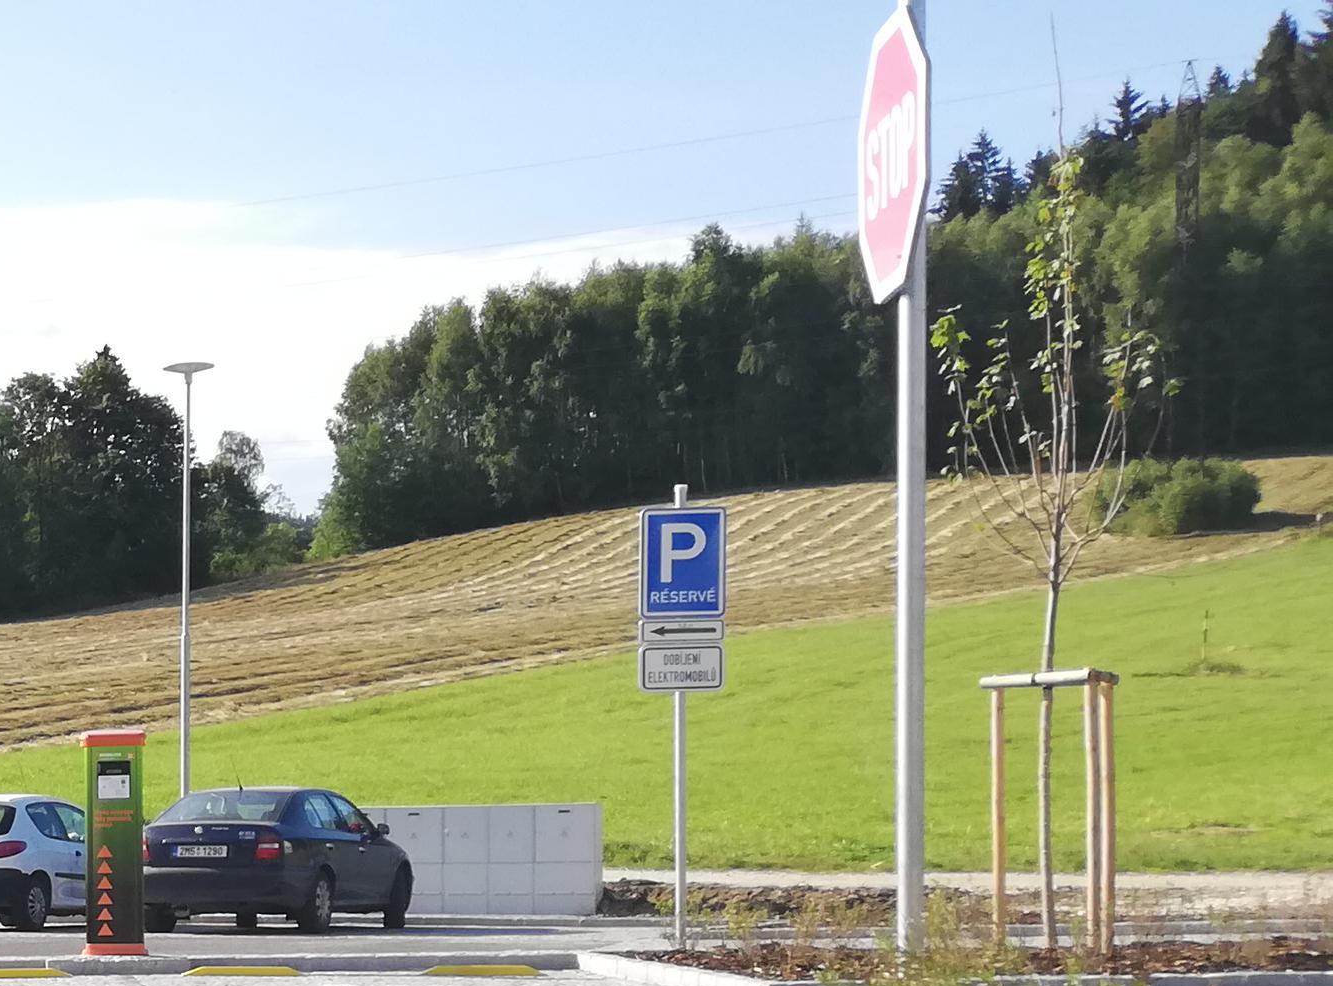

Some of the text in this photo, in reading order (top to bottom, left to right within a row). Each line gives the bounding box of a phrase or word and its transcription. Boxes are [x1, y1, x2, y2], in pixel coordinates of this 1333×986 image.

[866, 90, 915, 221] STOP
[660, 522, 707, 584] P
[650, 587, 717, 604] RÉSERVÉ
